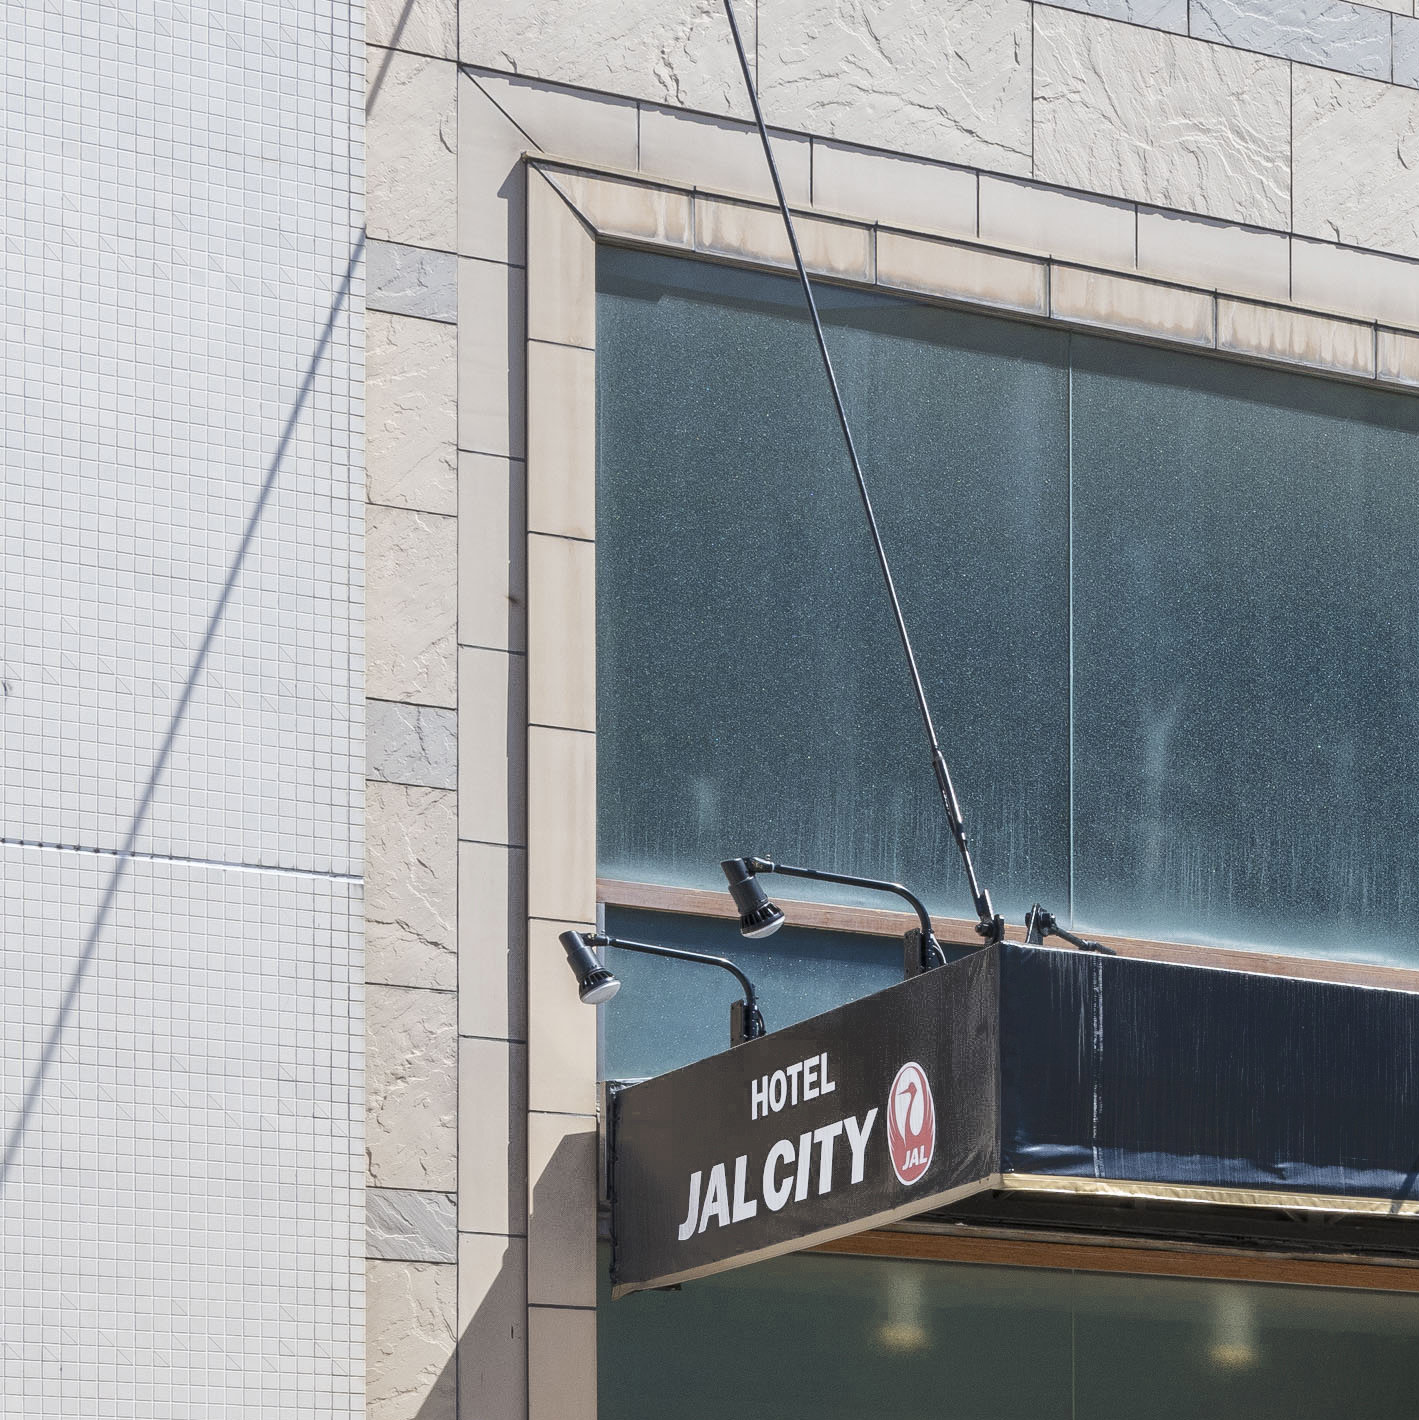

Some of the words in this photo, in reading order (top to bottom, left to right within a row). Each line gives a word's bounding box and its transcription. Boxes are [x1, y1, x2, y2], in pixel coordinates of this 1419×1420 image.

[751, 1052, 836, 1121] HOTEL
[677, 1154, 758, 1241] JAL
[762, 1107, 879, 1212] CITY
[902, 1144, 928, 1171] JAL
